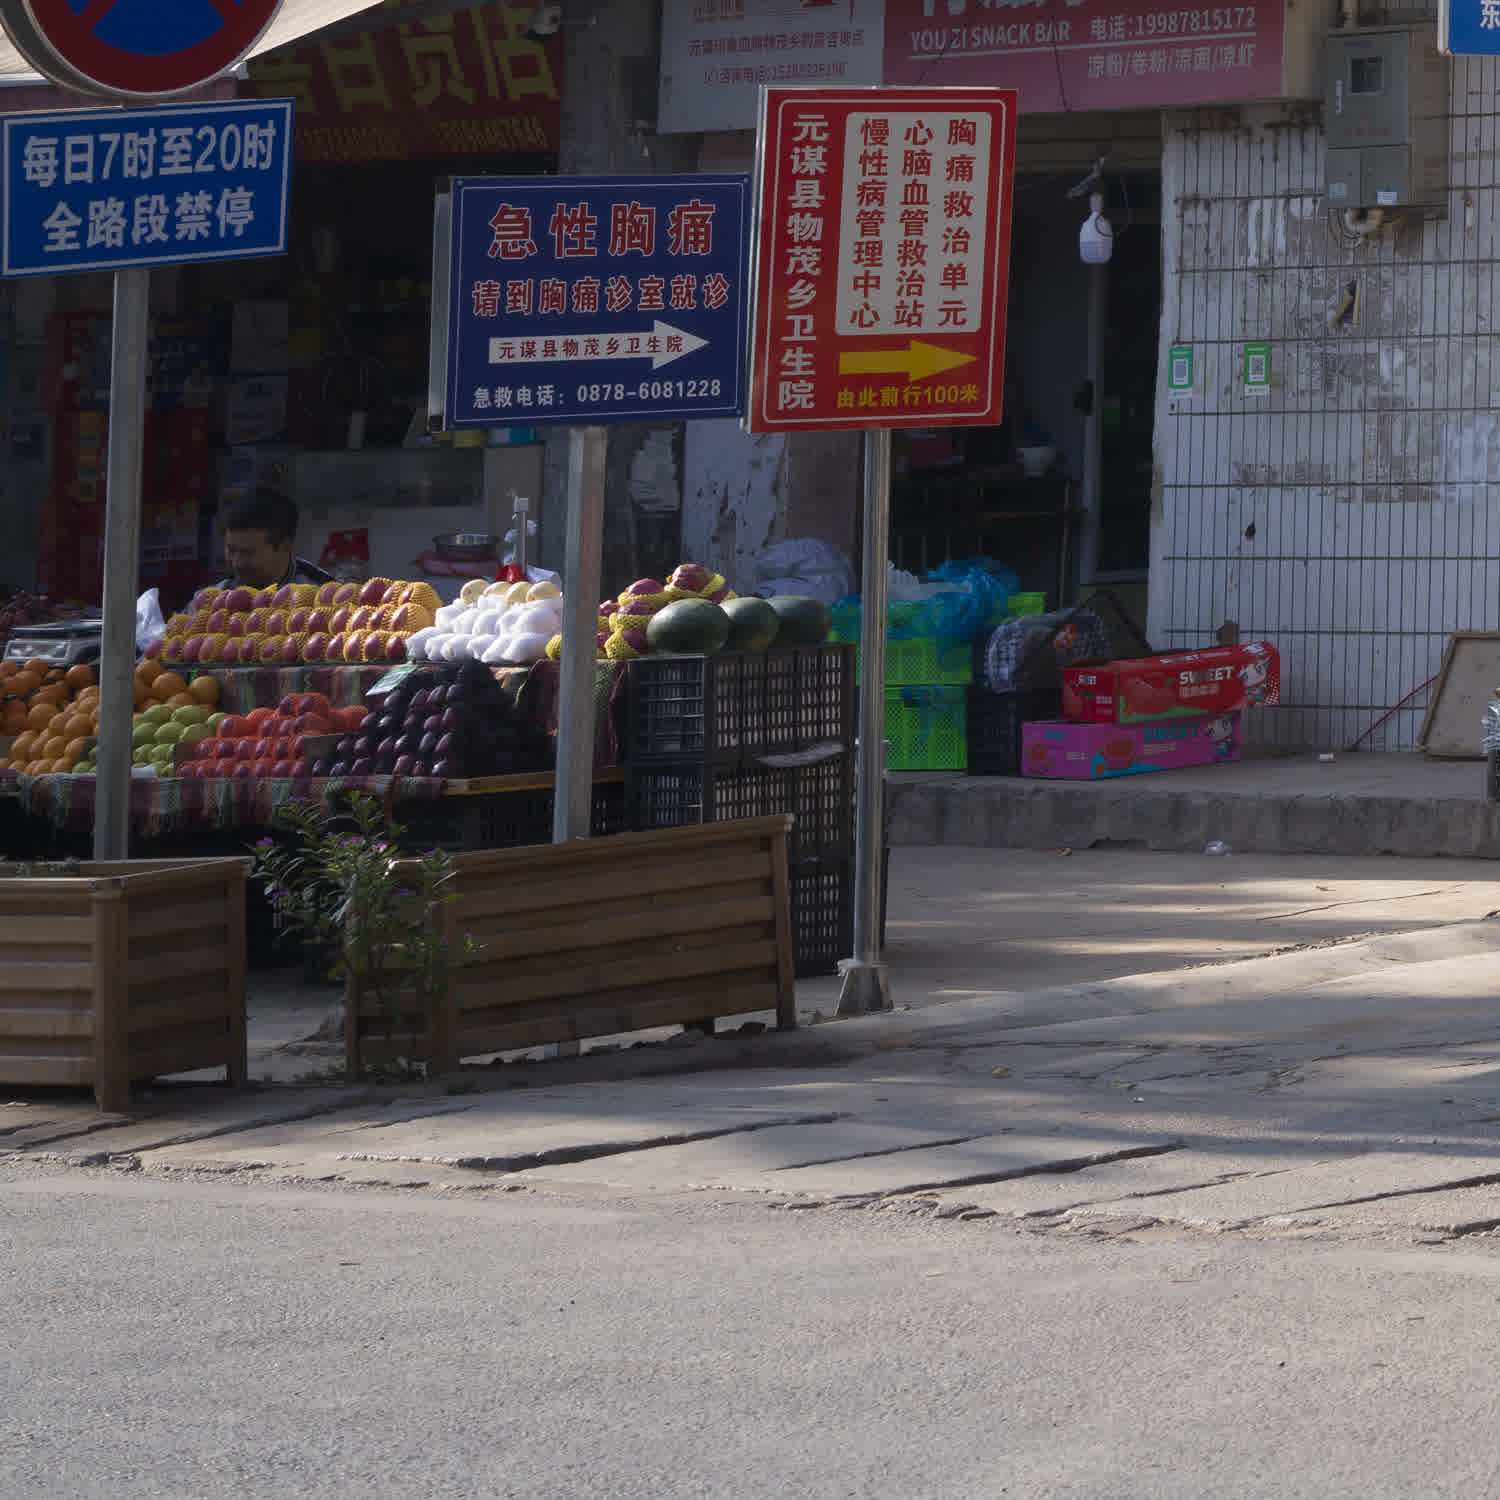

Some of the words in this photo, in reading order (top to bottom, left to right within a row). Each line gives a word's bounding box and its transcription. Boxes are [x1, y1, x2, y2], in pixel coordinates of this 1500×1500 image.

[910, 29, 945, 53] YOU
[971, 23, 1031, 49] SNACK
[1035, 20, 1072, 43] BAR
[23, 120, 276, 187] 每日7时至20时
[42, 186, 254, 252] 全路段禁停
[488, 200, 716, 259] 急性胸痛
[850, 118, 890, 328] 慢性病管理中心
[894, 119, 933, 328] 心脑血管救治站
[938, 118, 977, 327] 胸痛救治单元
[472, 272, 729, 317] 请到胸痛诊室就诊
[777, 113, 829, 411] 元谋县物茂乡卫生院
[498, 335, 684, 359] 元谋县物茂乡卫生院
[837, 383, 979, 408] 由此前行100米
